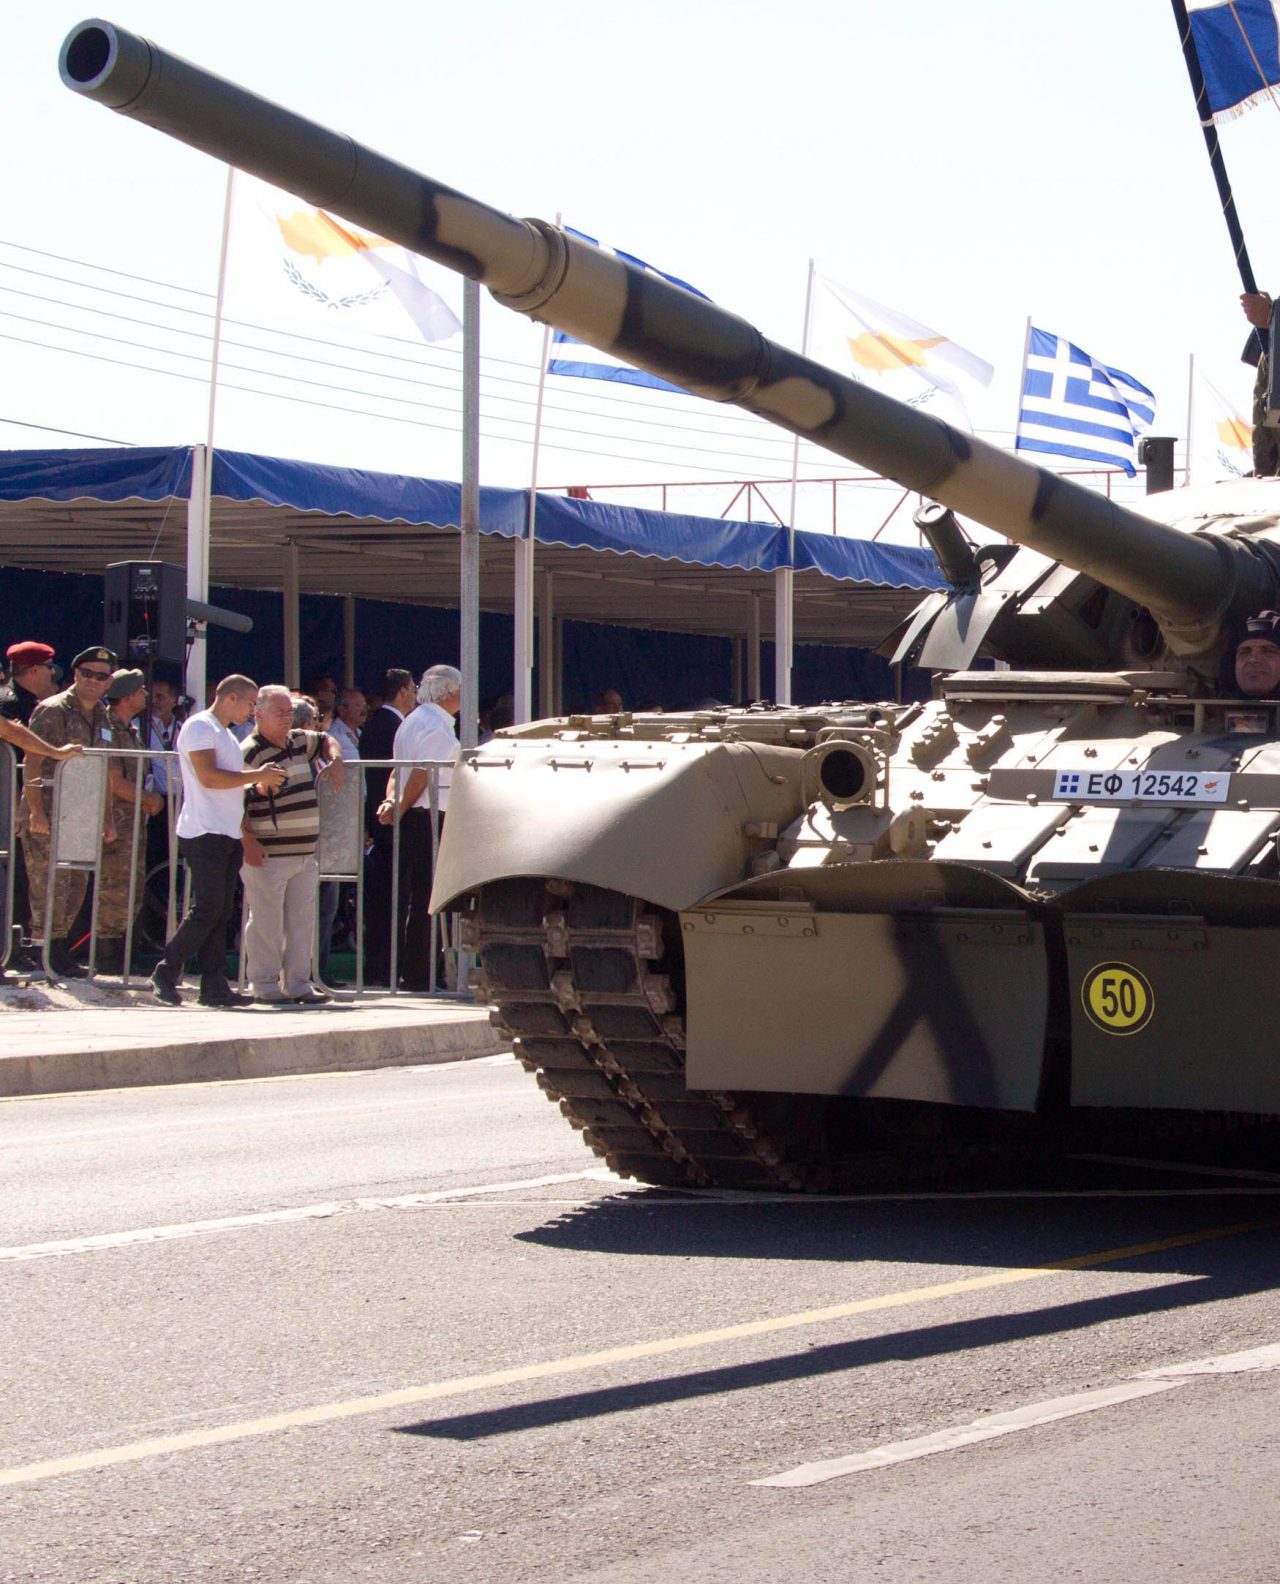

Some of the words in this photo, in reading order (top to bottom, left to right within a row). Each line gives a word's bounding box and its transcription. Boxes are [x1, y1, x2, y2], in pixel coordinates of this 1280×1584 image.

[1087, 773, 1123, 795] ΕΦ
[1131, 774, 1198, 796] 12542
[1102, 978, 1136, 1018] 50
